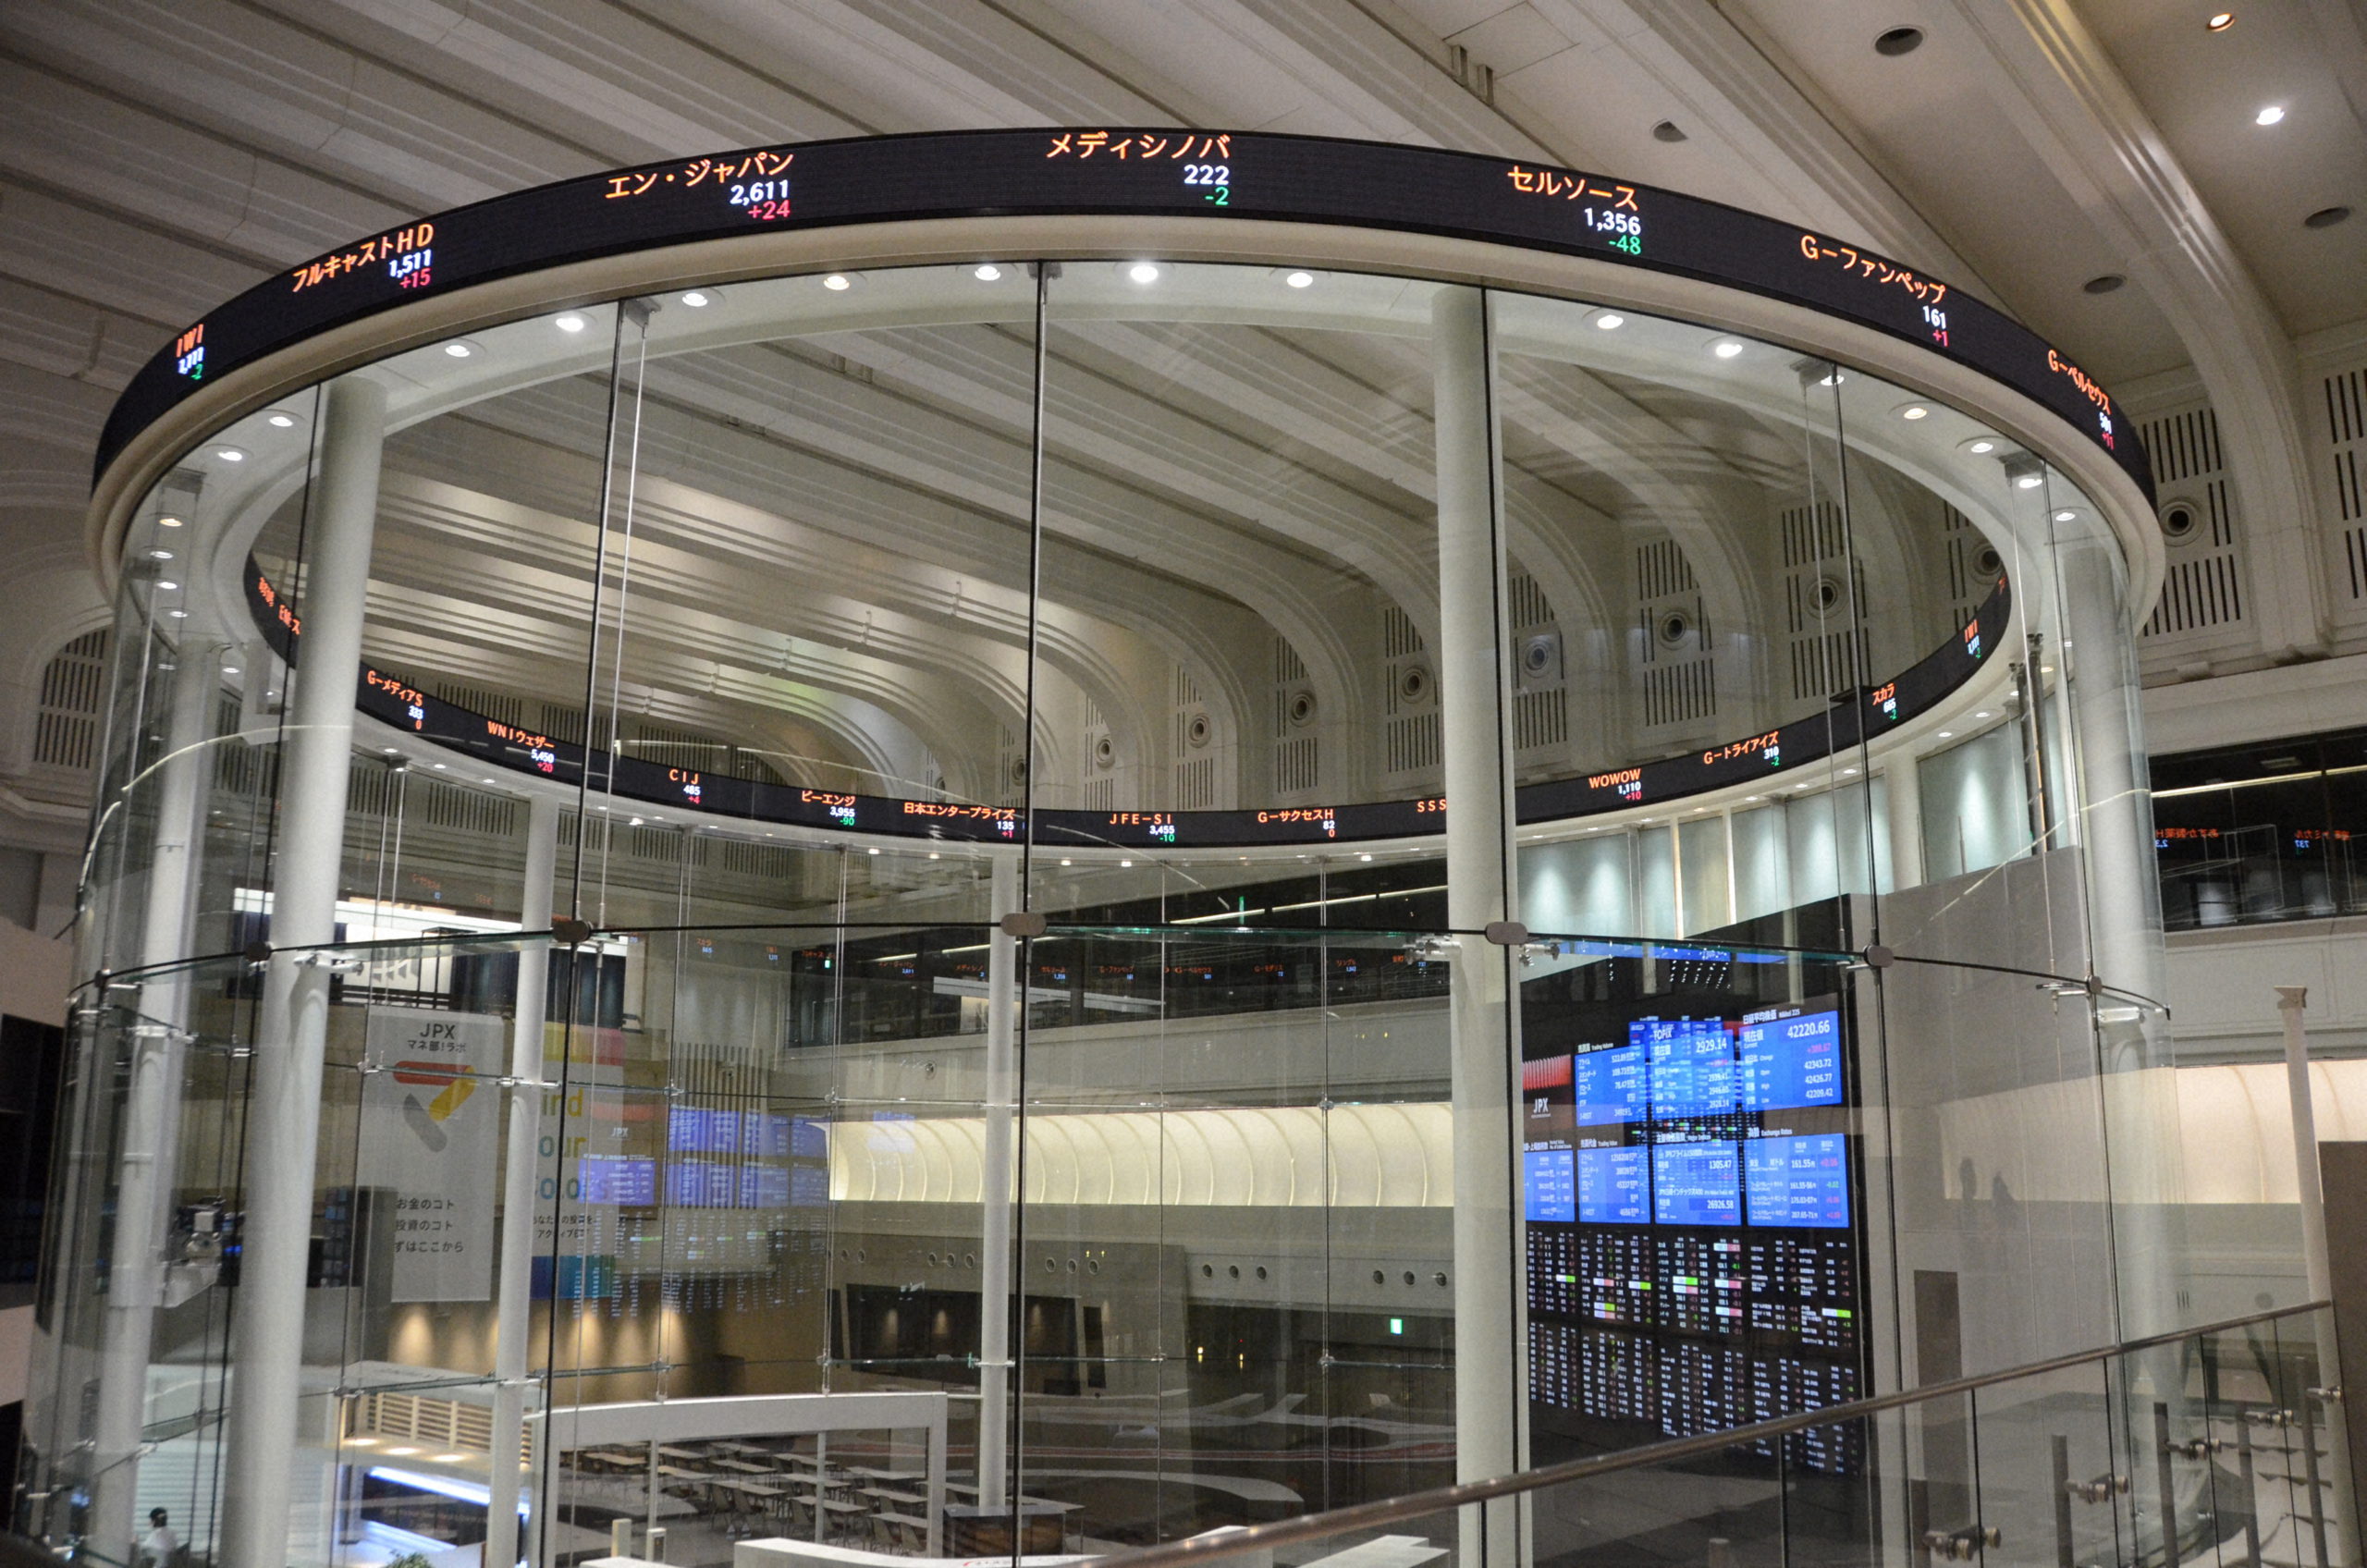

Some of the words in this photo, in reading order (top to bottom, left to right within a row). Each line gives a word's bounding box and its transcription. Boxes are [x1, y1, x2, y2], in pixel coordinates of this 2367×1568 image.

[1046, 130, 1231, 160] メディシノバ
[606, 152, 793, 199] エン・ジャパン
[1184, 165, 1230, 185] 222
[730, 179, 789, 205] 2,611
[1205, 187, 1229, 205] -2
[1507, 165, 1638, 212] セルソース
[748, 199, 790, 220] +24
[1584, 207, 1641, 236] 1,356
[1608, 235, 1641, 255] -48
[292, 223, 435, 292] フルキャストHD
[389, 249, 432, 278] 1,511
[399, 267, 431, 288] +15
[1922, 305, 1946, 329] 161
[1588, 768, 1641, 790] WOWOW
[802, 790, 856, 807] ビーエンジ
[829, 806, 855, 817] 3,955
[903, 802, 1014, 821] 日本エンタープライズ
[997, 820, 1014, 830] 135
[1149, 825, 1174, 835] 3,455
[1323, 820, 1335, 830] 82
[420, 1023, 456, 1040] JPX
[1653, 1026, 1673, 1041] TOPIX
[1787, 1020, 1831, 1038] 42220.66
[1696, 1036, 1727, 1054] 2929.14
[1804, 1058, 1832, 1070] 42343.72
[1533, 1097, 1549, 1113] JPX
[1709, 1159, 1732, 1170] 1305.47
[397, 1197, 455, 1210] お金のコト
[1707, 1199, 1734, 1209] 26926.58
